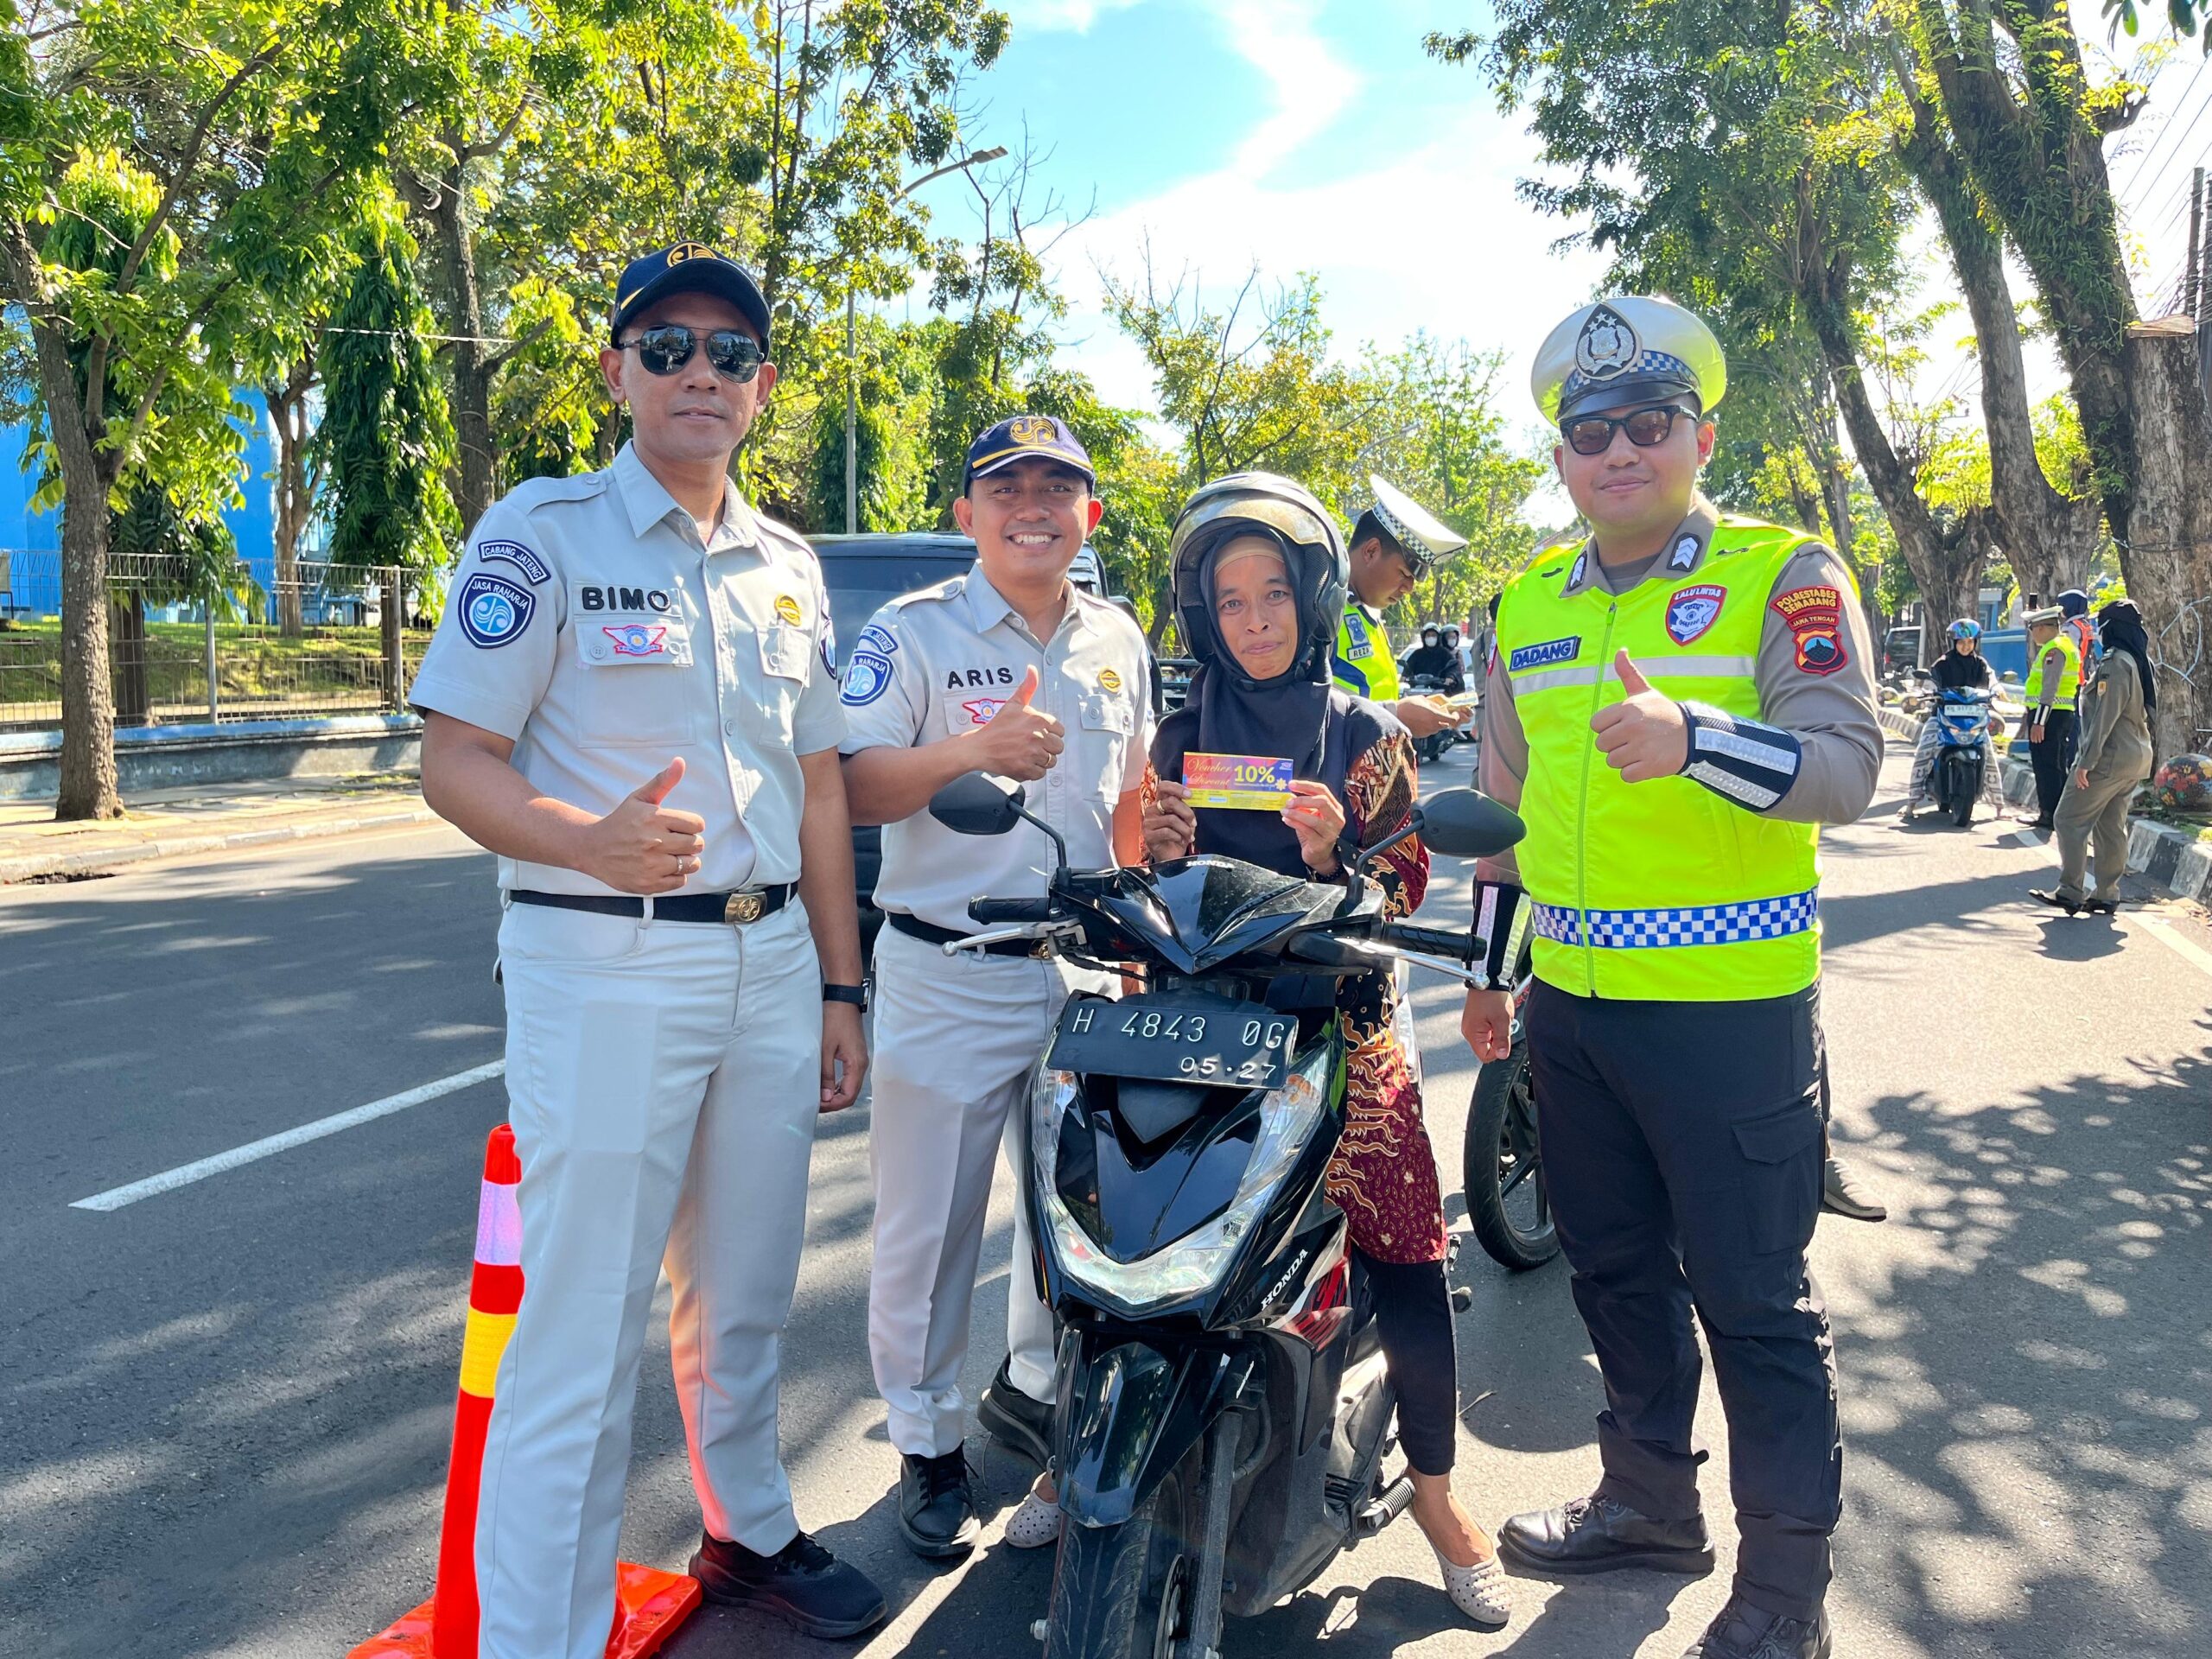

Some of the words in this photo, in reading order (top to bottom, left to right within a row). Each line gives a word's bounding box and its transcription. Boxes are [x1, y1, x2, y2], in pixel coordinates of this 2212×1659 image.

[485, 545, 517, 556] CABANG
[516, 552, 543, 579] JATENG
[472, 581, 492, 592] JASA
[493, 584, 529, 610] RAHARJA
[582, 587, 671, 612] BIMO
[1674, 588, 1696, 601] LALU
[1695, 587, 1722, 597] LINTAS
[1776, 588, 1837, 609] POLRESTABES
[1783, 597, 1836, 615] SEMARANG
[1793, 617, 1809, 627] JAWA
[1513, 641, 1572, 668] DADANG
[947, 667, 1014, 690] ARIS
[1187, 758, 1231, 772] Voucher
[1234, 765, 1275, 784] 10%
[1185, 860, 1236, 869] HONDA
[1072, 1007, 1095, 1033] H
[1121, 1011, 1206, 1042] 4843
[1261, 1249, 1309, 1312] HONDA
